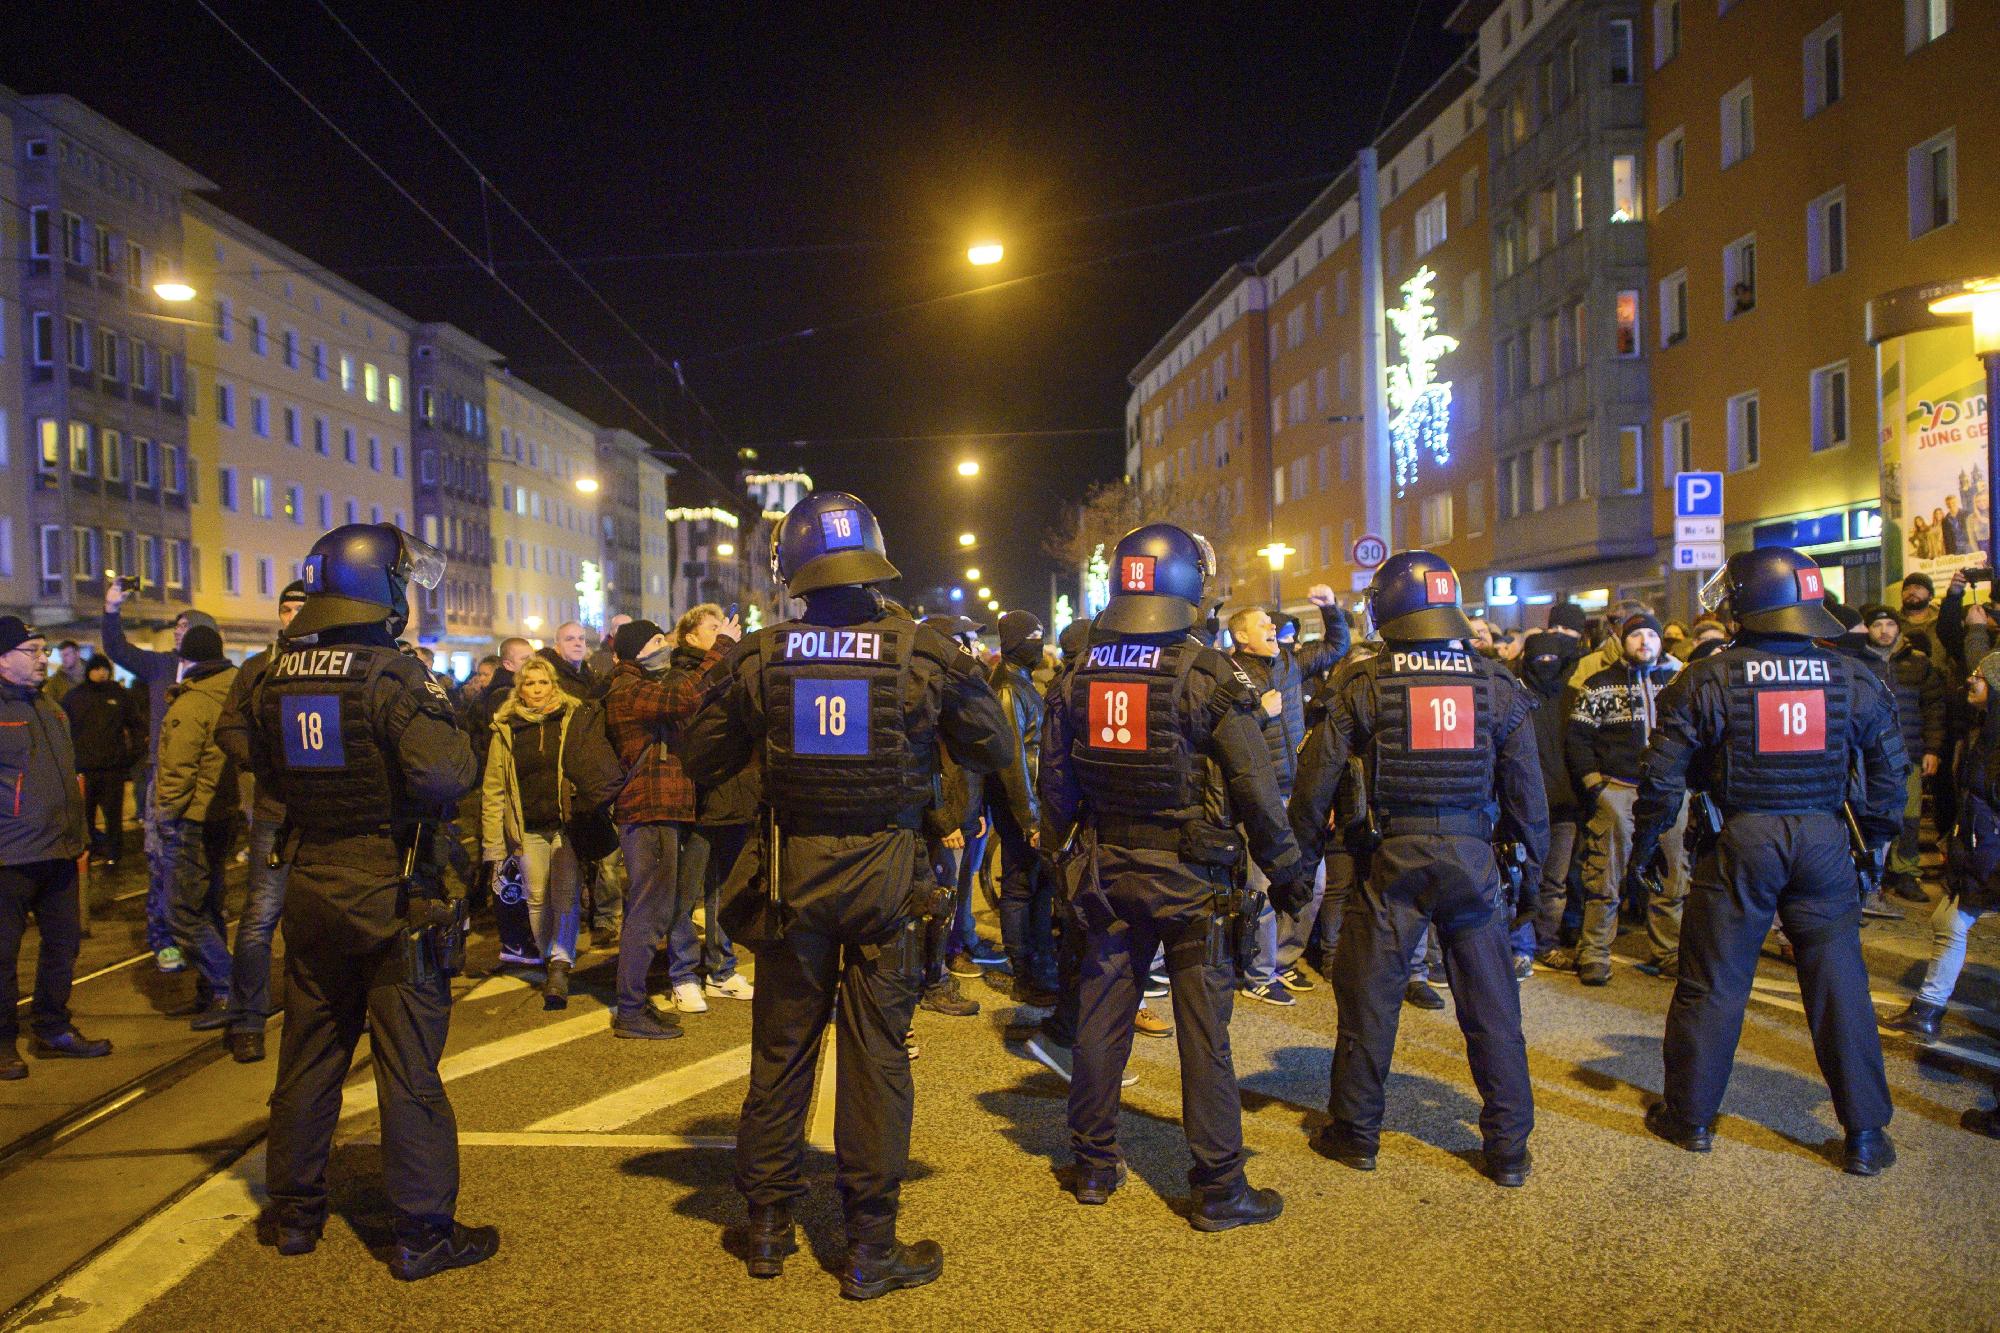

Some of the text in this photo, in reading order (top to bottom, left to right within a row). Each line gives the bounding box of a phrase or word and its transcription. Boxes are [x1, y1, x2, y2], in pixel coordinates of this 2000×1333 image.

[1919, 428, 1961, 449] JUNG
[1686, 478, 1712, 512] P
[833, 517, 851, 538] 18
[1360, 545, 1380, 560] 30
[306, 564, 314, 584] 18
[1131, 562, 1145, 580] 18
[1435, 577, 1449, 595] 18
[1806, 575, 1819, 593] 18
[786, 631, 880, 659] POLIZEI
[1086, 644, 1161, 668] POLIZEI
[276, 651, 353, 676] POLIZEI
[1393, 650, 1473, 672] POLIZEI
[1746, 659, 1830, 682] POLIZEI
[815, 695, 846, 736] 18
[1104, 690, 1128, 726] 18
[1430, 697, 1457, 731] 18
[1779, 702, 1807, 736] 18
[297, 711, 324, 750] 18
